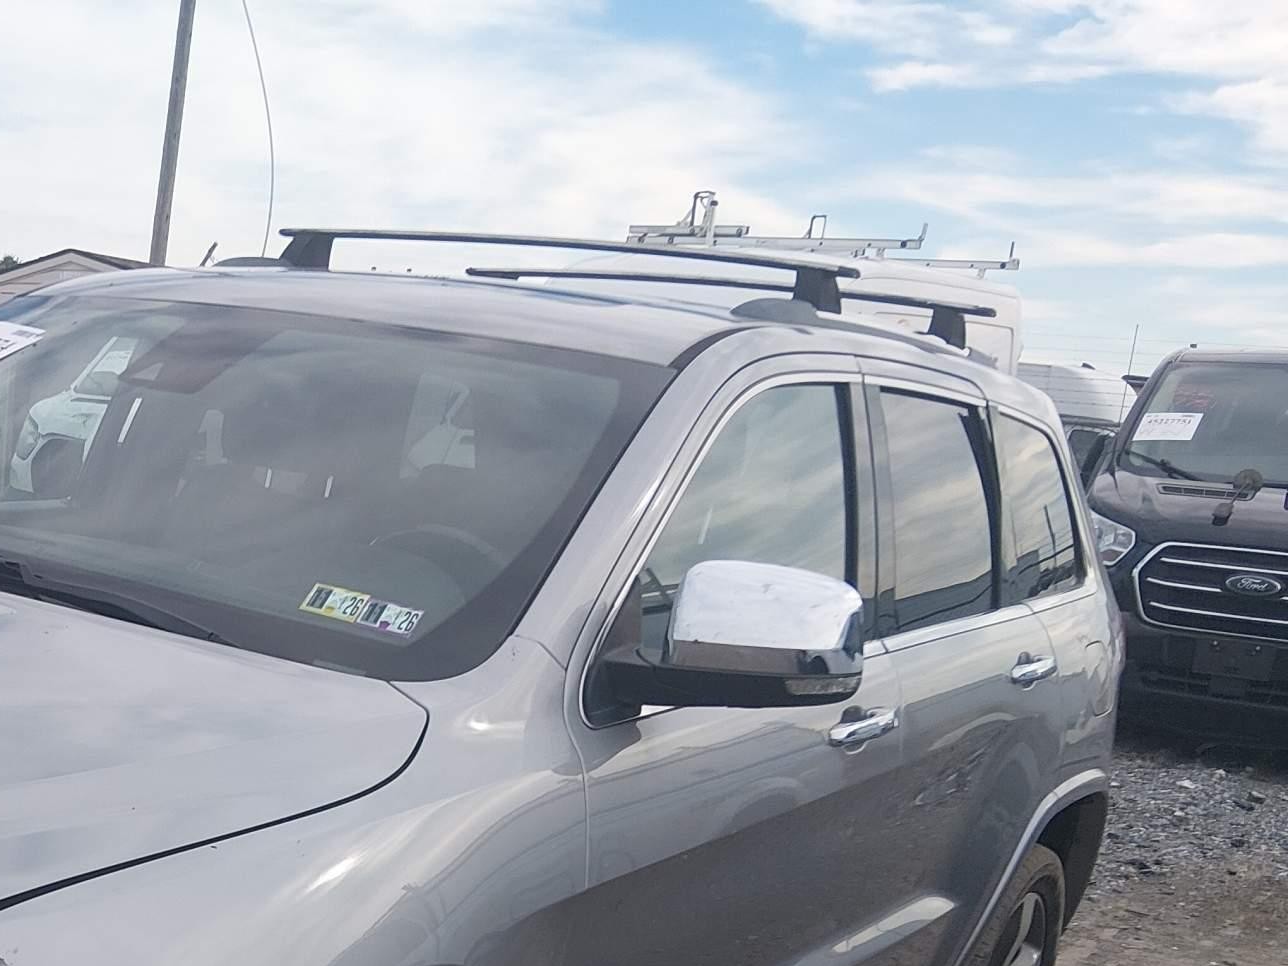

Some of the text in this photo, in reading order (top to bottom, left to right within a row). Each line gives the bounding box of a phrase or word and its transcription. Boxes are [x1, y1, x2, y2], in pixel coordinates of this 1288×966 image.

[1237, 577, 1267, 592] Ford
[343, 597, 364, 616] 26
[397, 611, 419, 632] 26
